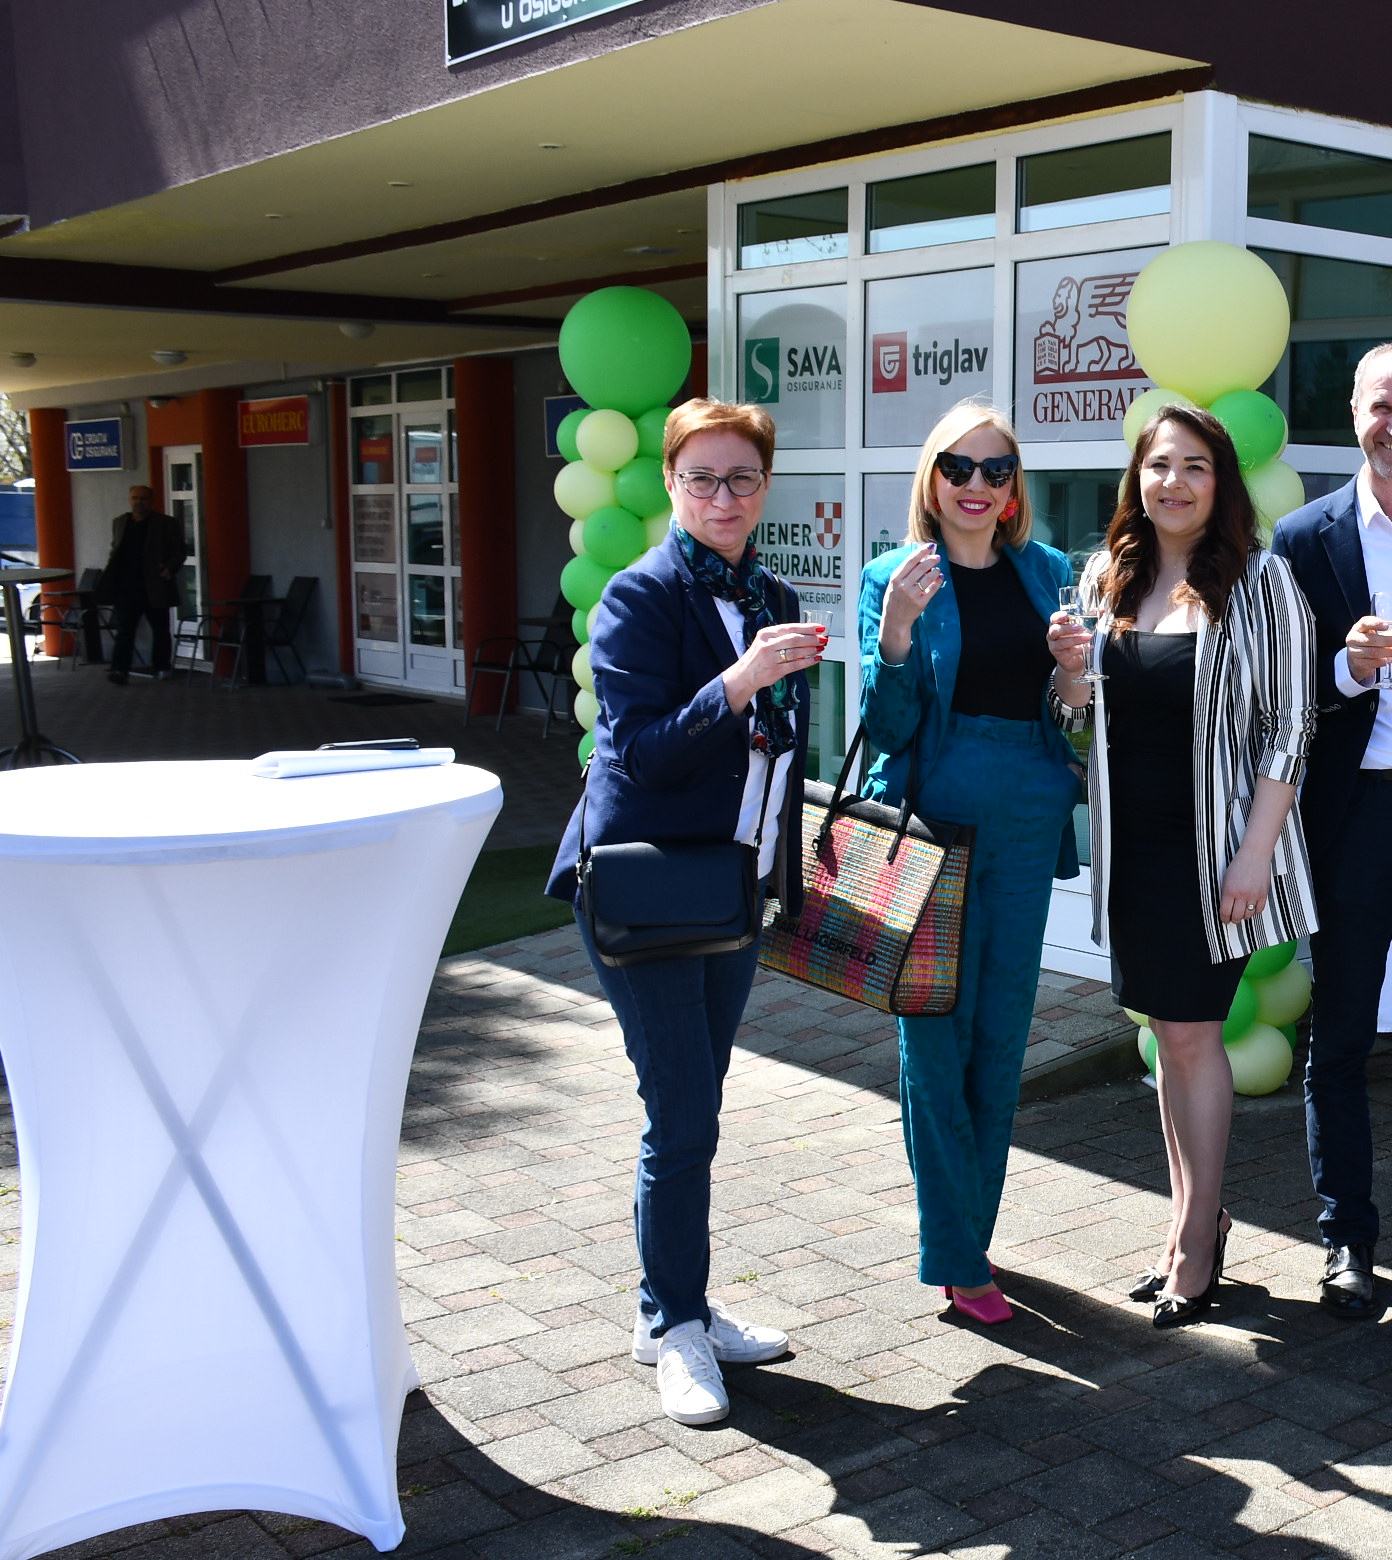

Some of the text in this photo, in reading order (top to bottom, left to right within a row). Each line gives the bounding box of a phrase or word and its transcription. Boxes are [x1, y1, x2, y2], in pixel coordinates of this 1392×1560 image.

[787, 345, 842, 378] SAVA
[912, 338, 988, 386] triglav
[786, 379, 842, 392] OSIGURANJE
[1033, 386, 1151, 424] GENERA
[756, 551, 842, 579] SIGURANJE
[815, 591, 842, 604] GROUP
